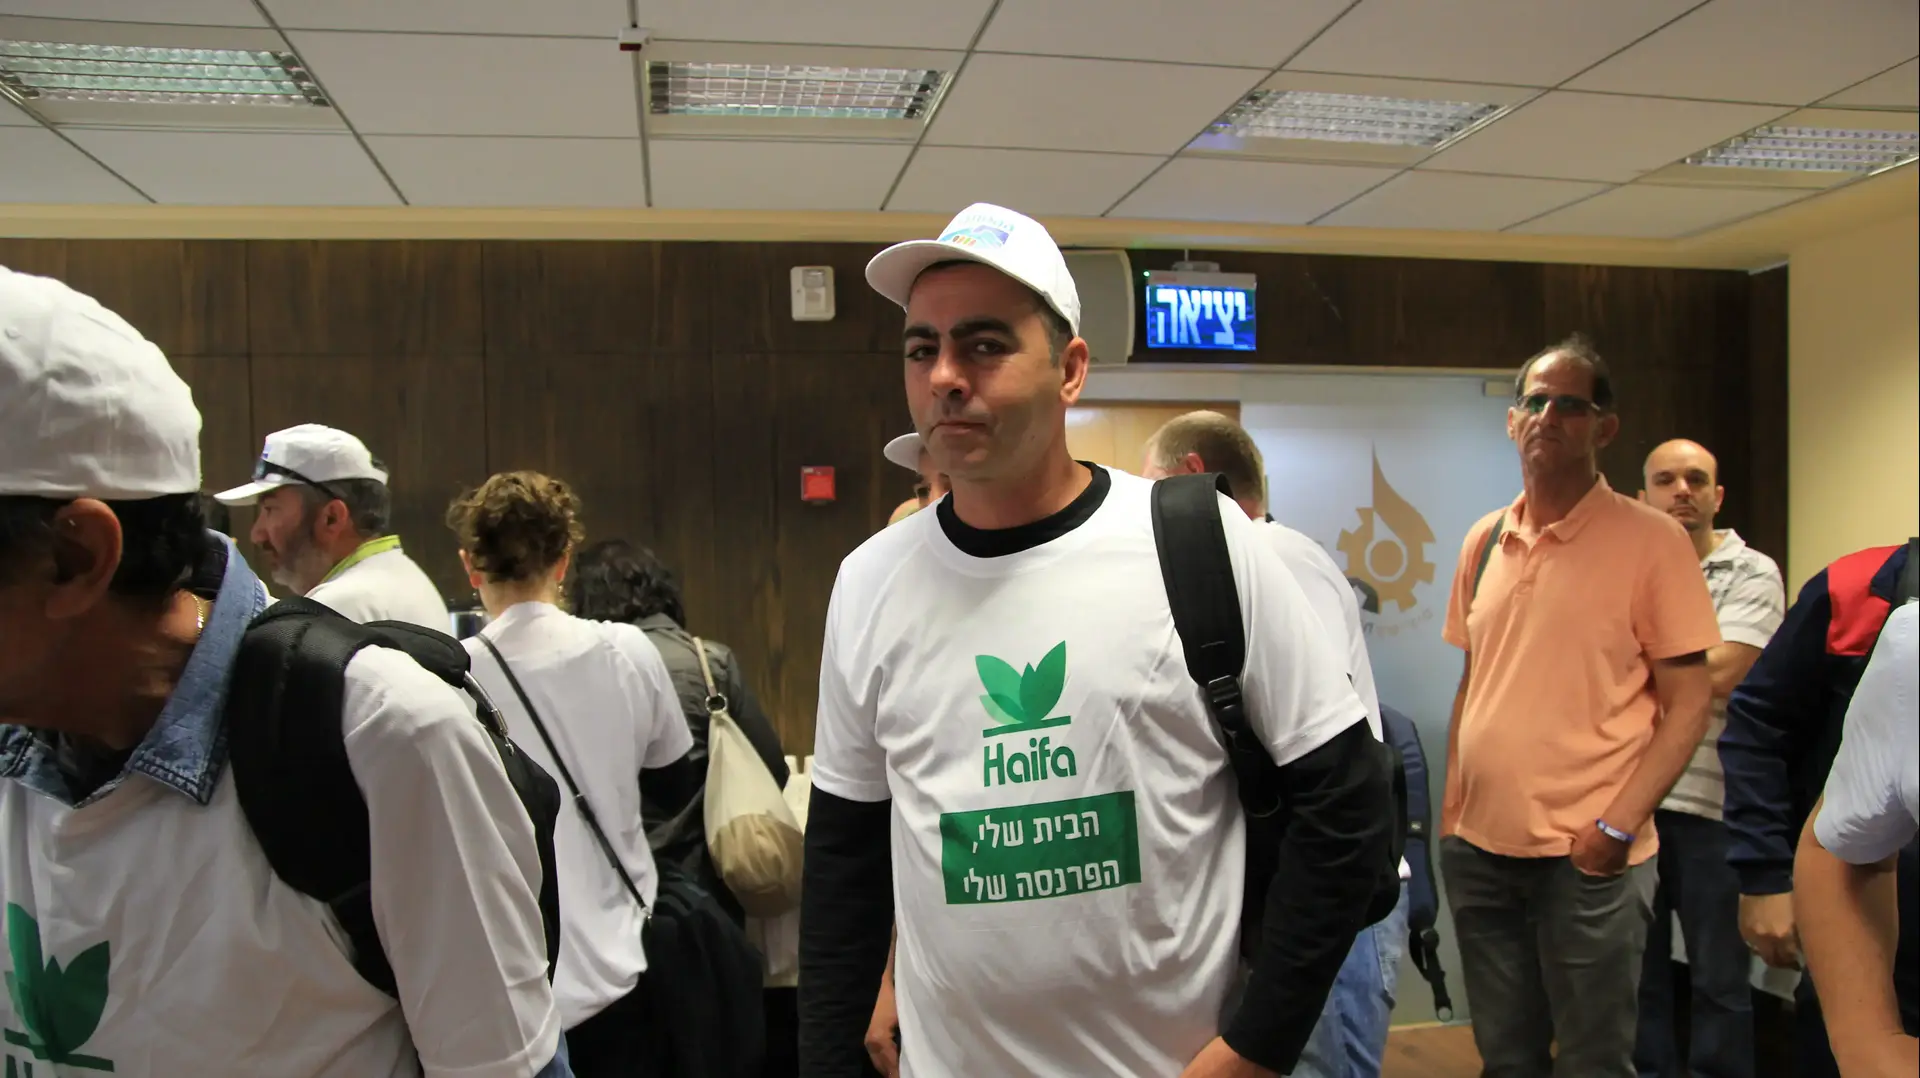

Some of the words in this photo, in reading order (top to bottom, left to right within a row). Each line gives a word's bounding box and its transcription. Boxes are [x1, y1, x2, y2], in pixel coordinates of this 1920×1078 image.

[1156, 288, 1246, 345] יציאה
[983, 736, 1077, 787] Haifa
[972, 814, 1024, 854] שלי,
[1032, 811, 1100, 845] הבית
[963, 868, 1008, 901] שלי
[1015, 860, 1121, 898] הפרנסה
